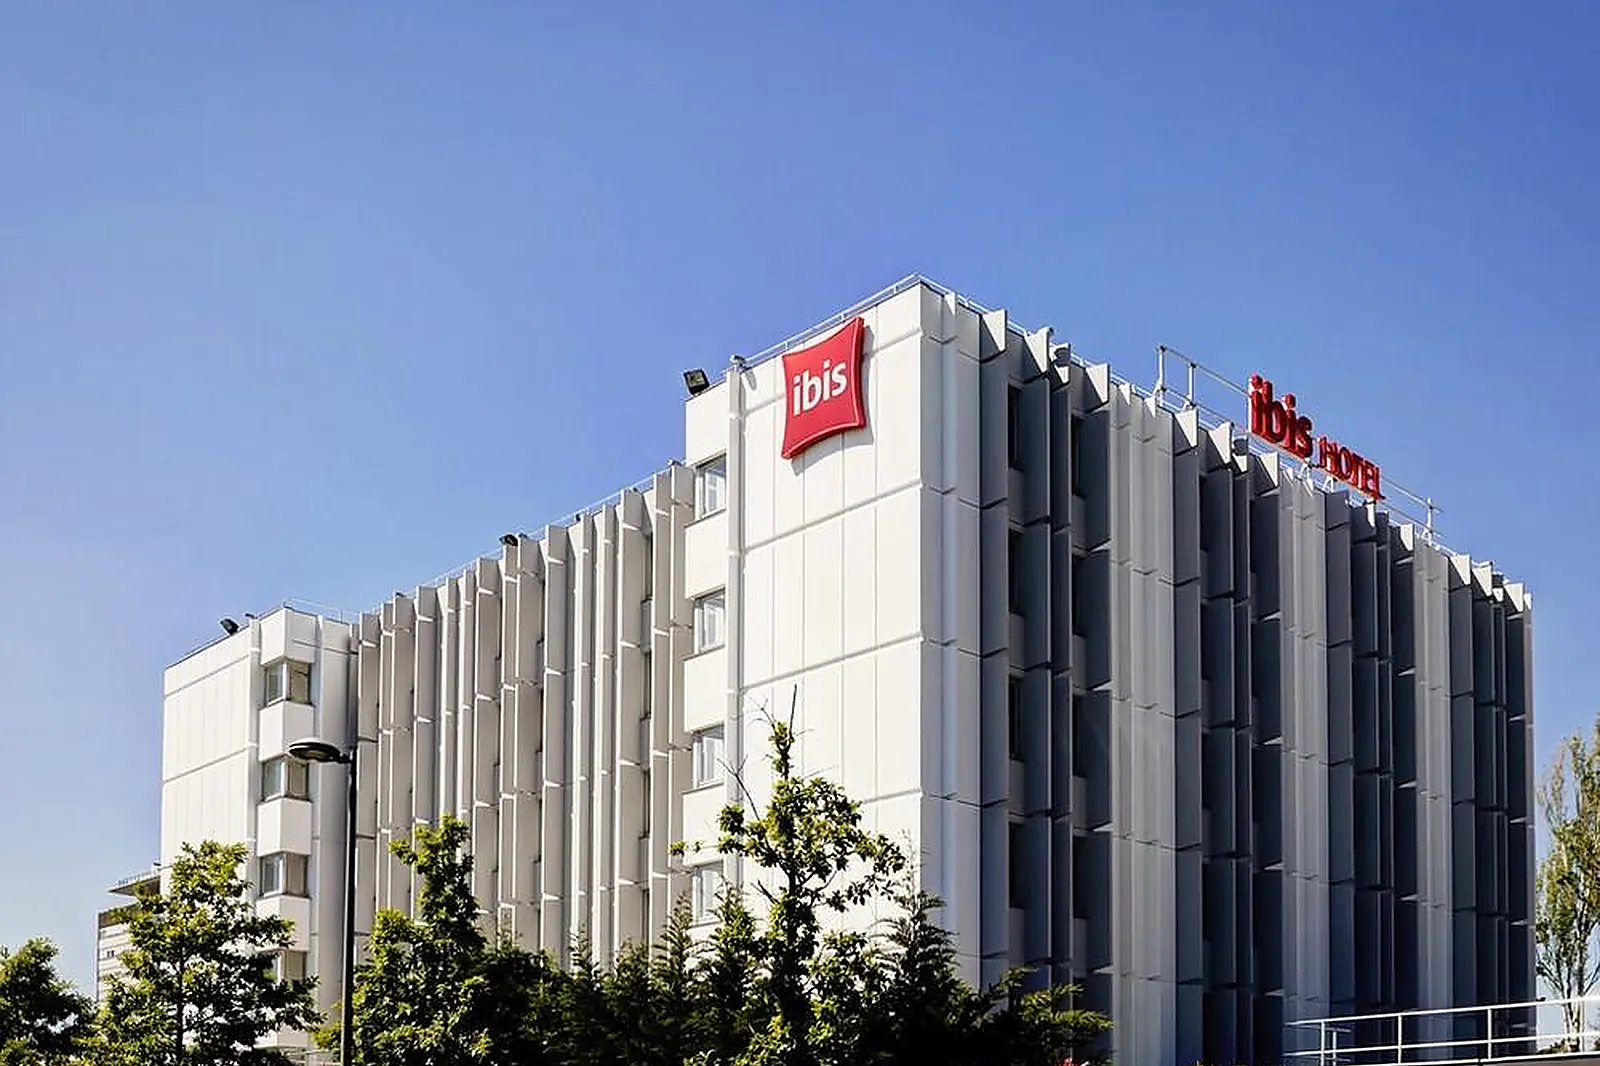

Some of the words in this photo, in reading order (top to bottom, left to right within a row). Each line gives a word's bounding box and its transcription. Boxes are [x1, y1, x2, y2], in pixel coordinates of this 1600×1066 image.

[793, 359, 848, 416] ibis
[1248, 374, 1313, 458] ibis
[1318, 437, 1380, 499] HOTEL
